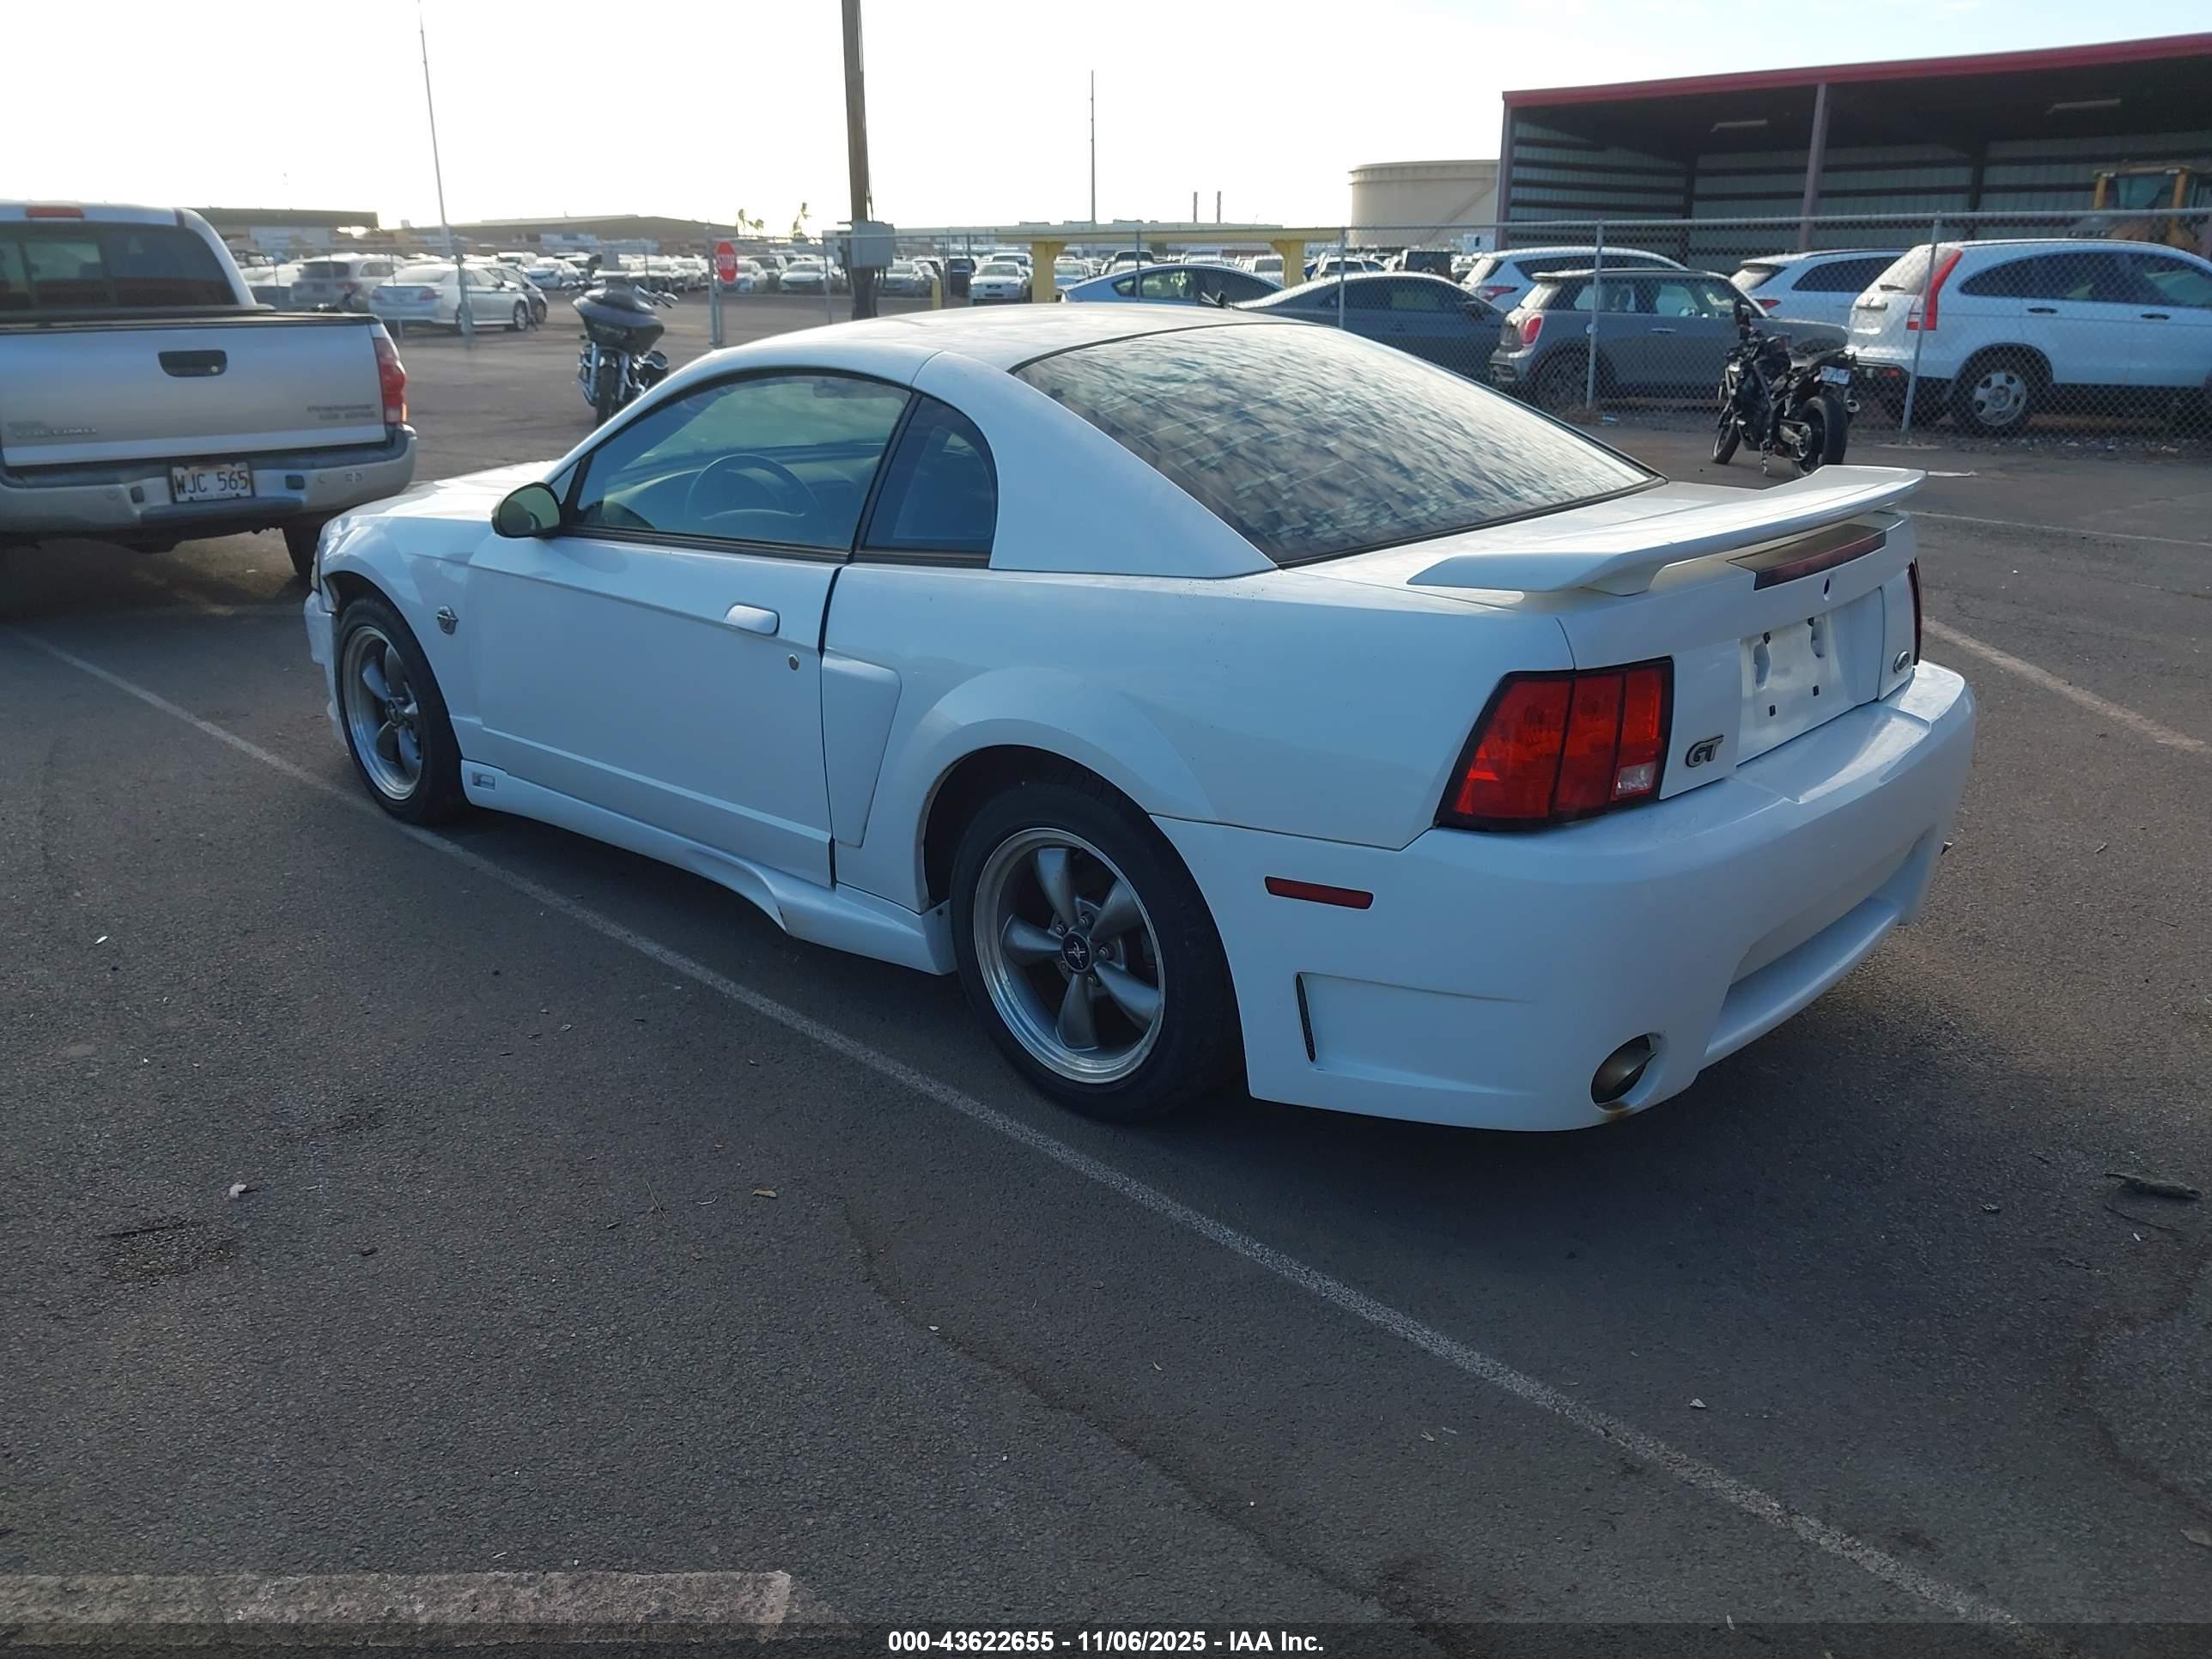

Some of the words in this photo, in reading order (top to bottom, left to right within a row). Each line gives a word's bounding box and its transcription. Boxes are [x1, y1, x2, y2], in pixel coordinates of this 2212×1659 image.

[174, 473, 207, 494] WJC
[216, 470, 248, 491] 565
[1685, 733, 1724, 768] GT
